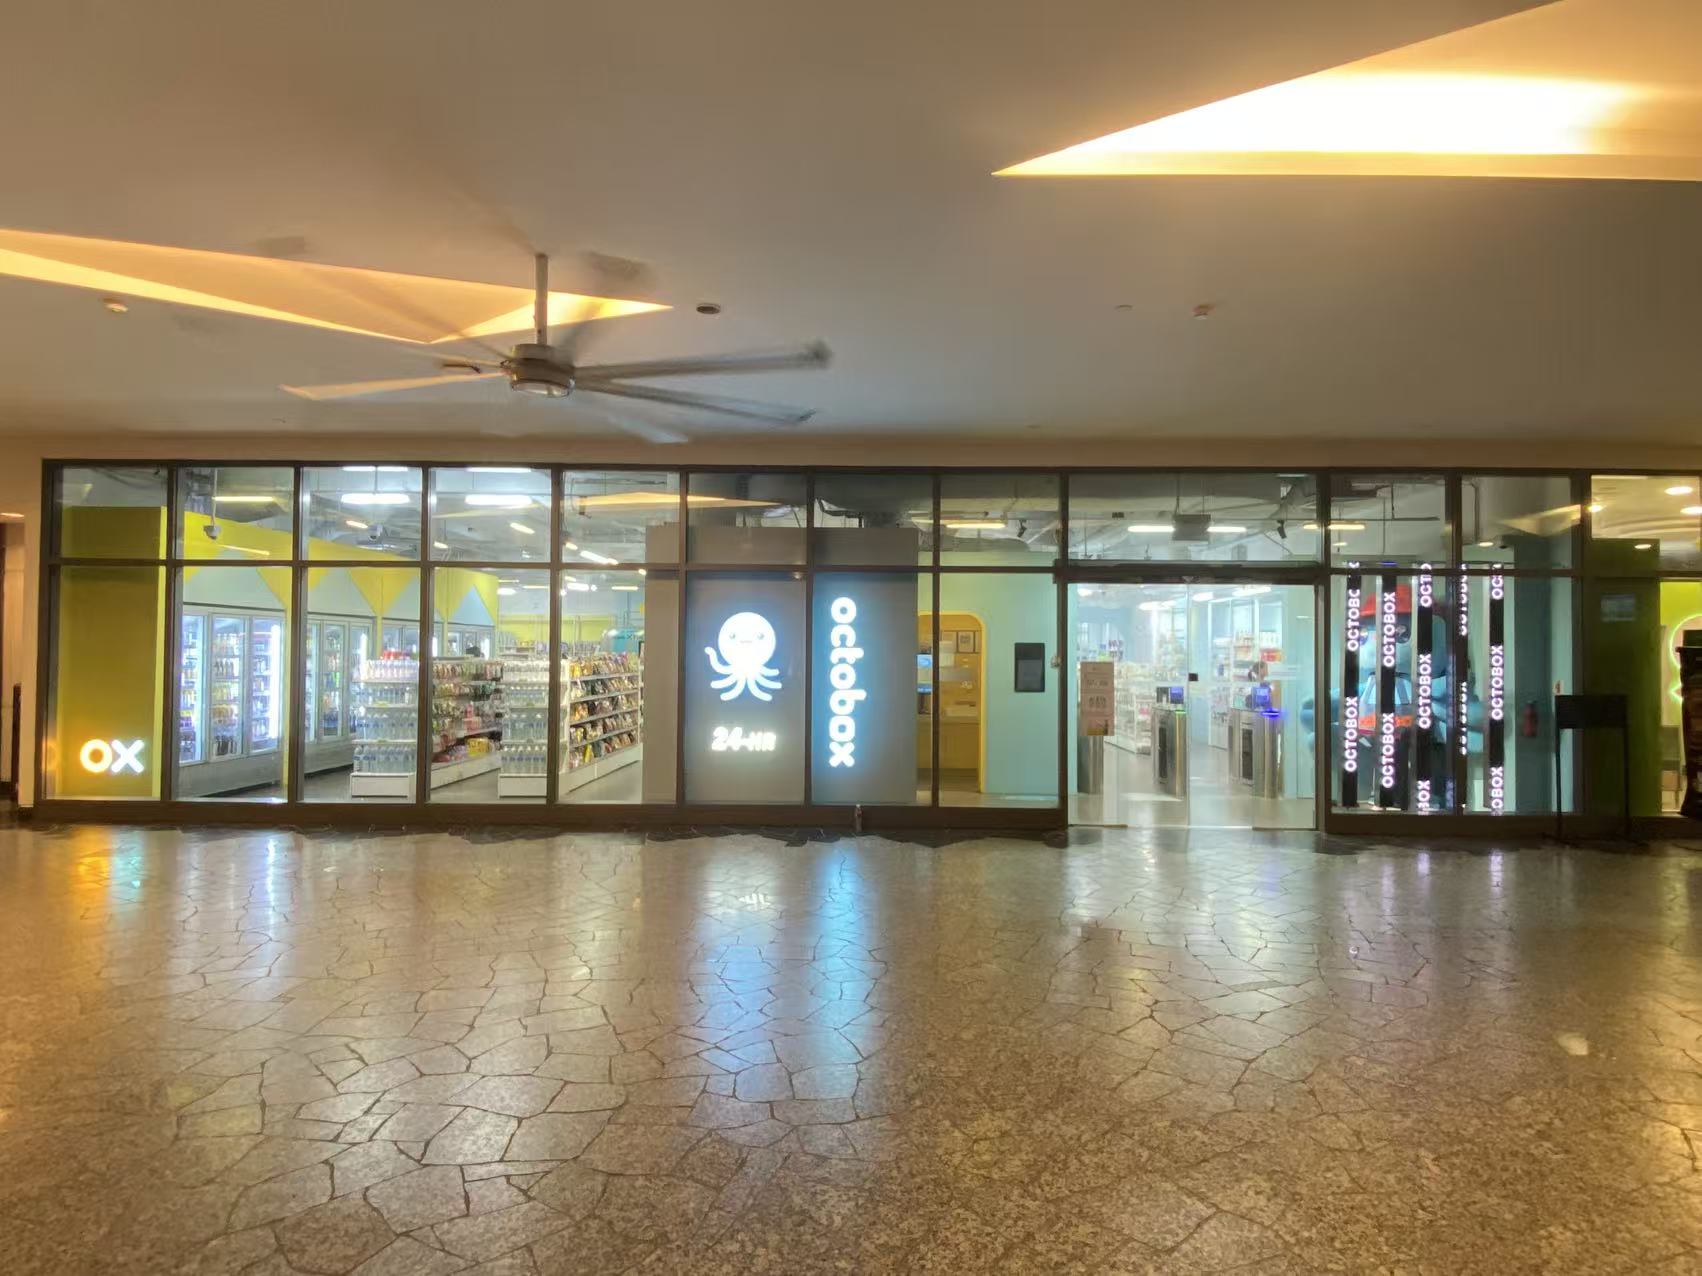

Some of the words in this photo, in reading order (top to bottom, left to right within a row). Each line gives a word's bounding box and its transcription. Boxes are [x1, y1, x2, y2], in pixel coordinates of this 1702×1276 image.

[1382, 591, 1396, 667] OCTOBOX
[829, 597, 867, 767] octobox
[1418, 653, 1432, 729] OCTOBOX
[1490, 645, 1504, 721] OCTOBOX
[1344, 696, 1358, 772] OCTOBOX
[1381, 713, 1395, 788] OCTOBOX
